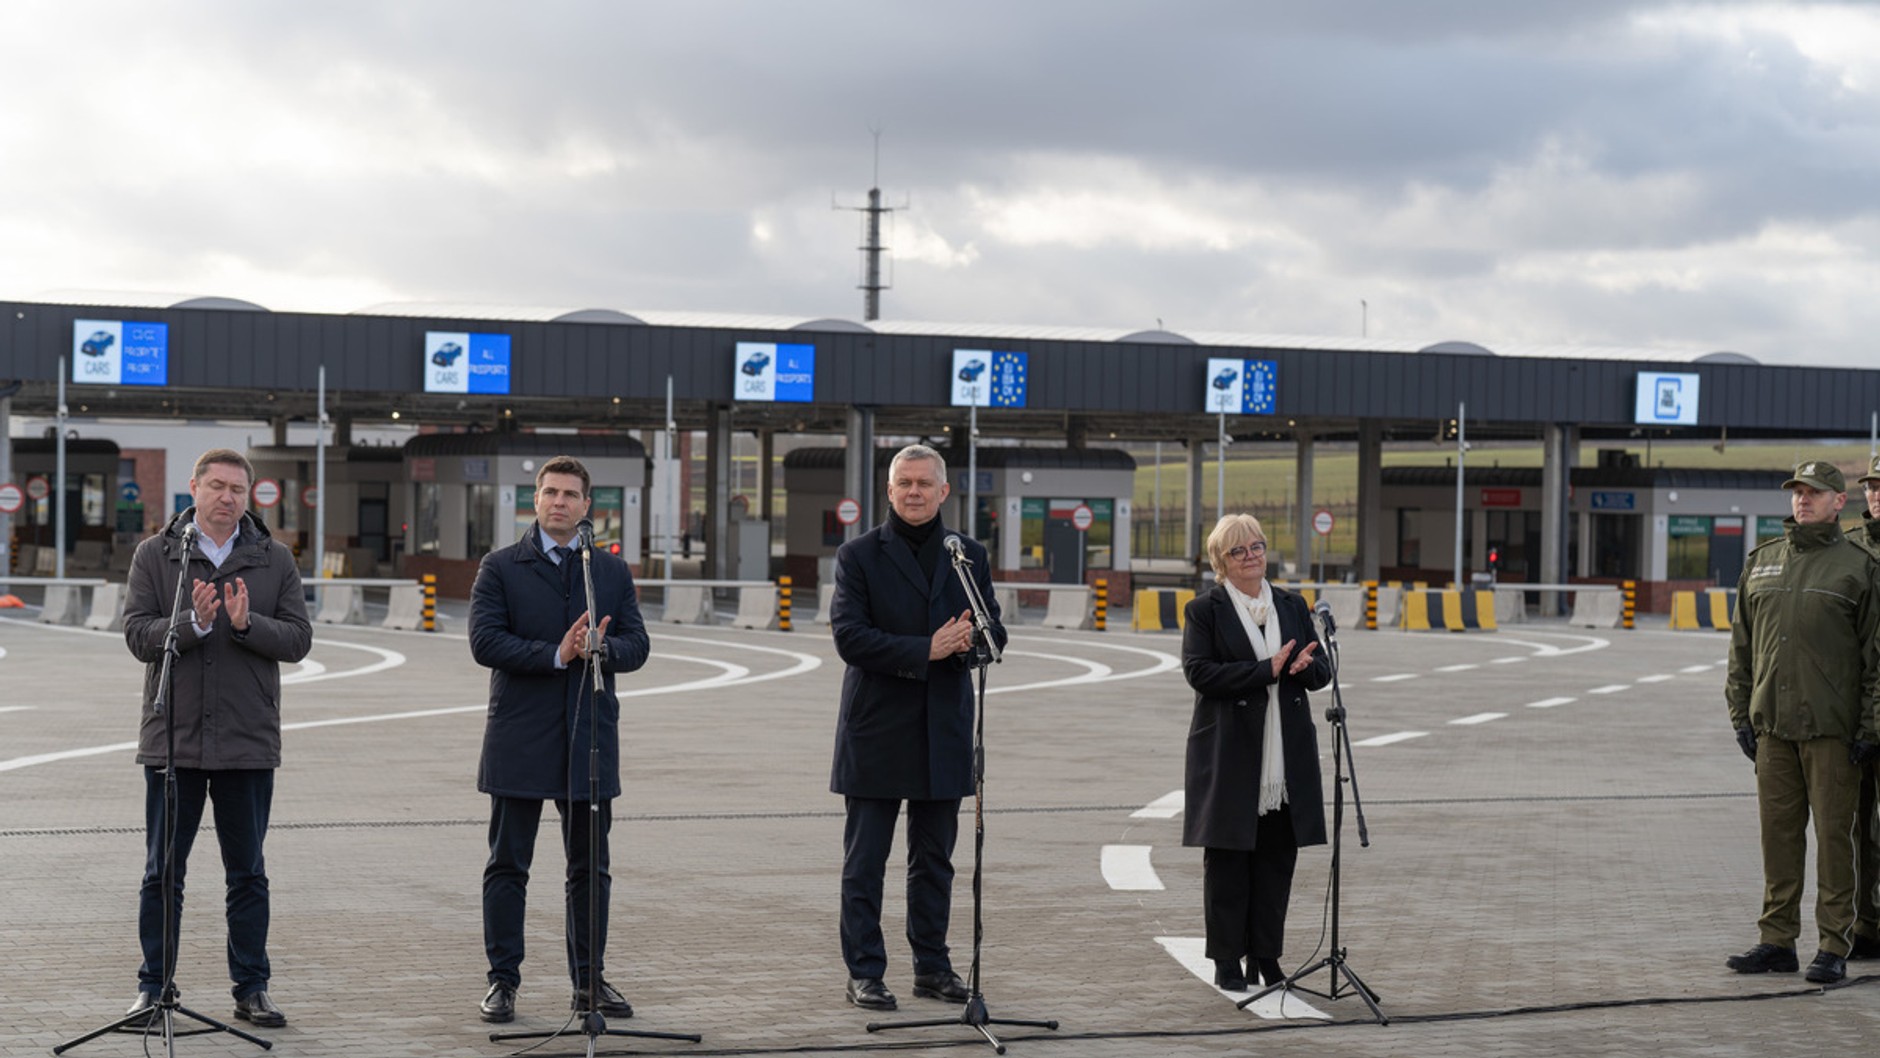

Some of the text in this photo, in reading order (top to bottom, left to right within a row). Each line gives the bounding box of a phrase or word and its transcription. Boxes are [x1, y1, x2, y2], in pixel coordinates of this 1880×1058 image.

[84, 361, 110, 375] CARS
[434, 371, 458, 384] CARS
[743, 380, 767, 393] CARS
